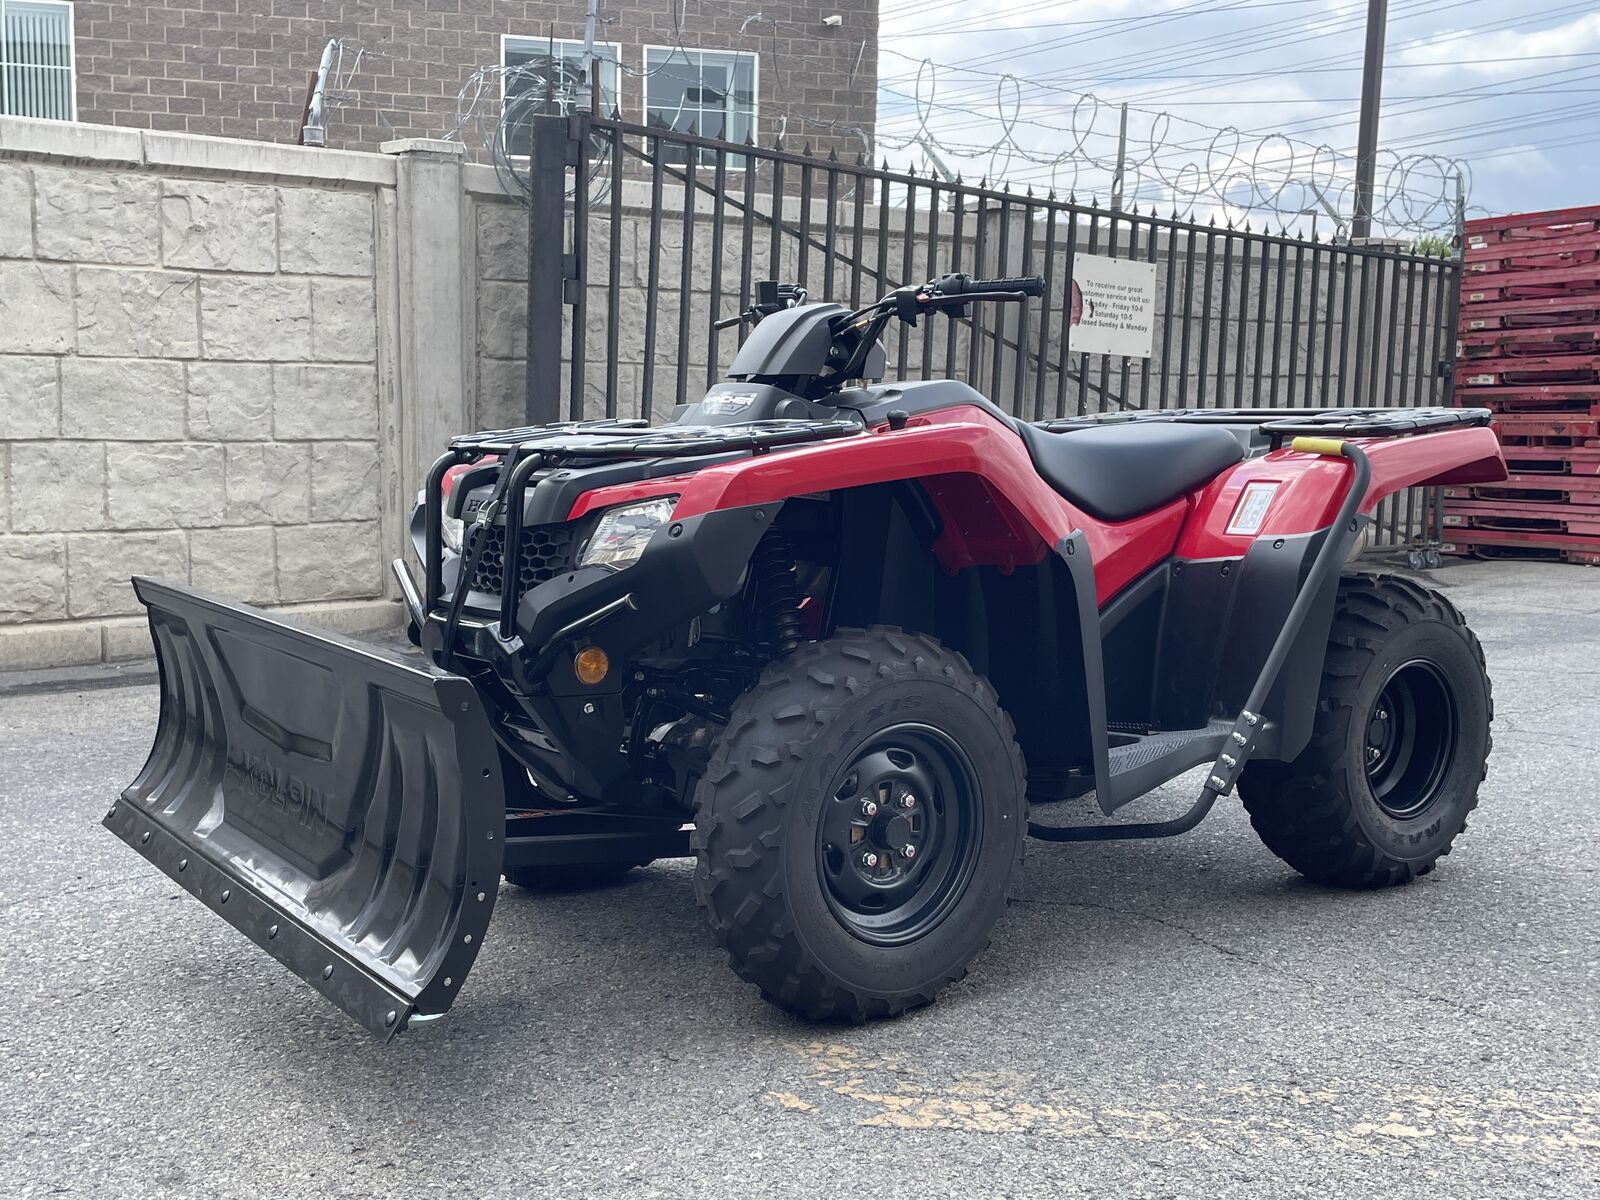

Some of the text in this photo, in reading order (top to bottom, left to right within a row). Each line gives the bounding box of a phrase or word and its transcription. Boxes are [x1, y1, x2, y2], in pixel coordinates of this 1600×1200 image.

[1094, 281, 1116, 289] receive
[1127, 286, 1143, 294] great
[1081, 290, 1105, 299] ustomer
[1106, 292, 1127, 301] service
[1128, 295, 1141, 303] visit
[1112, 302, 1130, 312] Friday
[1094, 310, 1119, 320] Saturday
[1081, 318, 1097, 326] losed
[1098, 320, 1119, 330] Sunday
[1126, 323, 1148, 332] Monday
